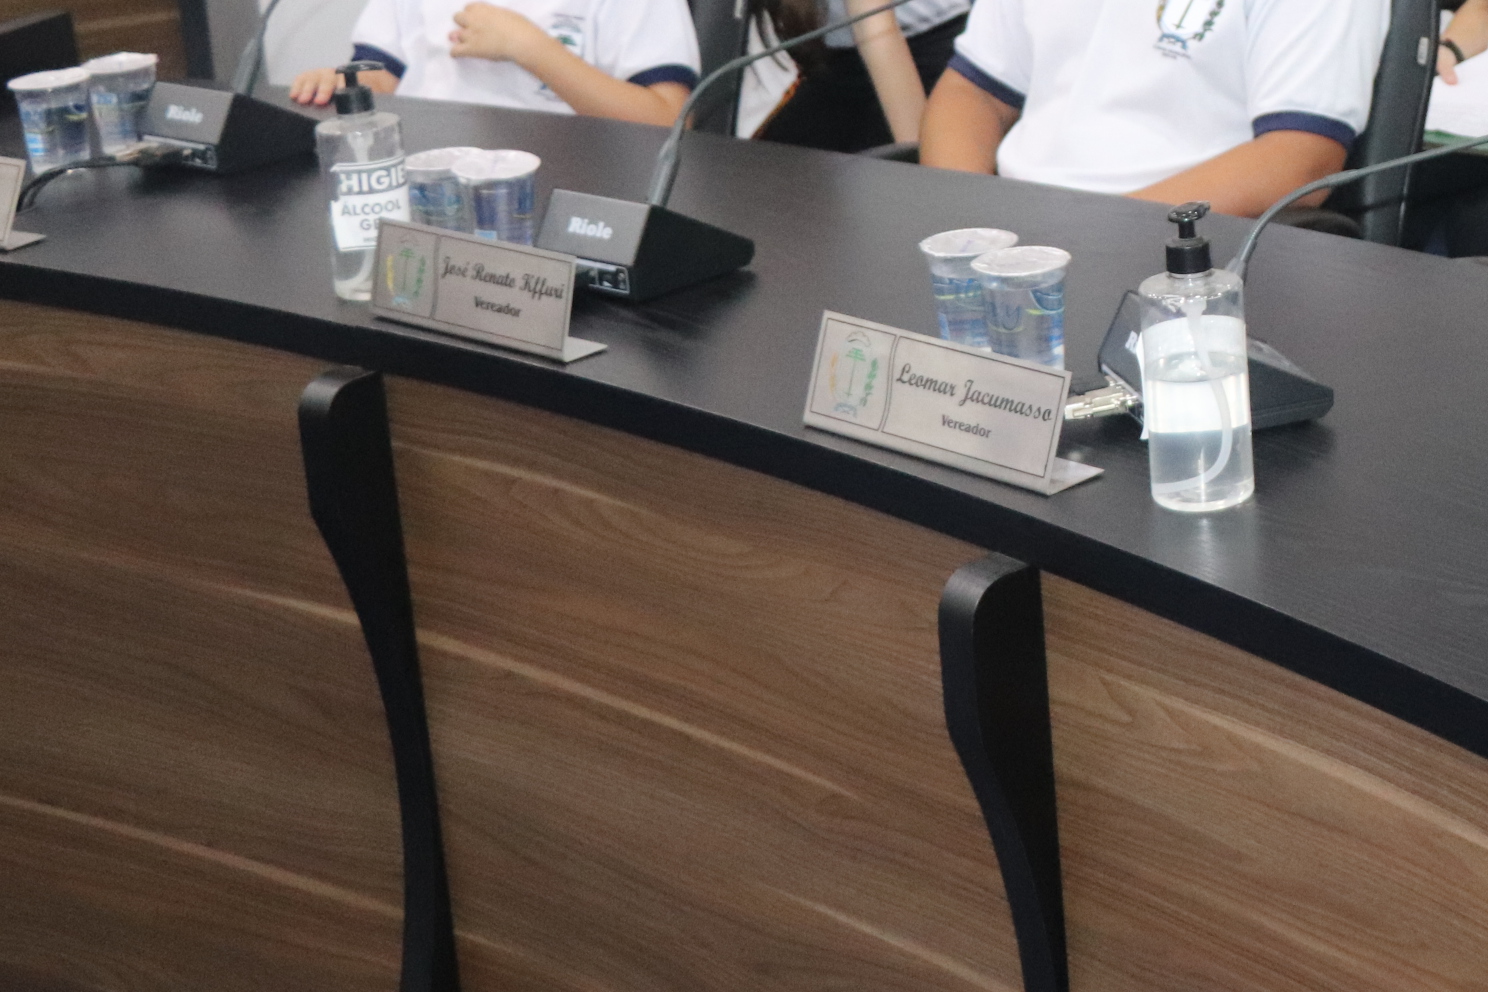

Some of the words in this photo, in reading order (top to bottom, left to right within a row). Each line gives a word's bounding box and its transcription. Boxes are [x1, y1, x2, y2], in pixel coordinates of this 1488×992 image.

[341, 198, 403, 216] ÁLCOOL
[360, 218, 380, 230] GE
[568, 216, 613, 239] Riole
[441, 256, 470, 279] José
[472, 263, 516, 288] Renato
[474, 295, 521, 318] Vereador
[896, 362, 956, 397] Leomar
[959, 379, 1053, 422] Jacumasso
[942, 413, 992, 438] Vereador
